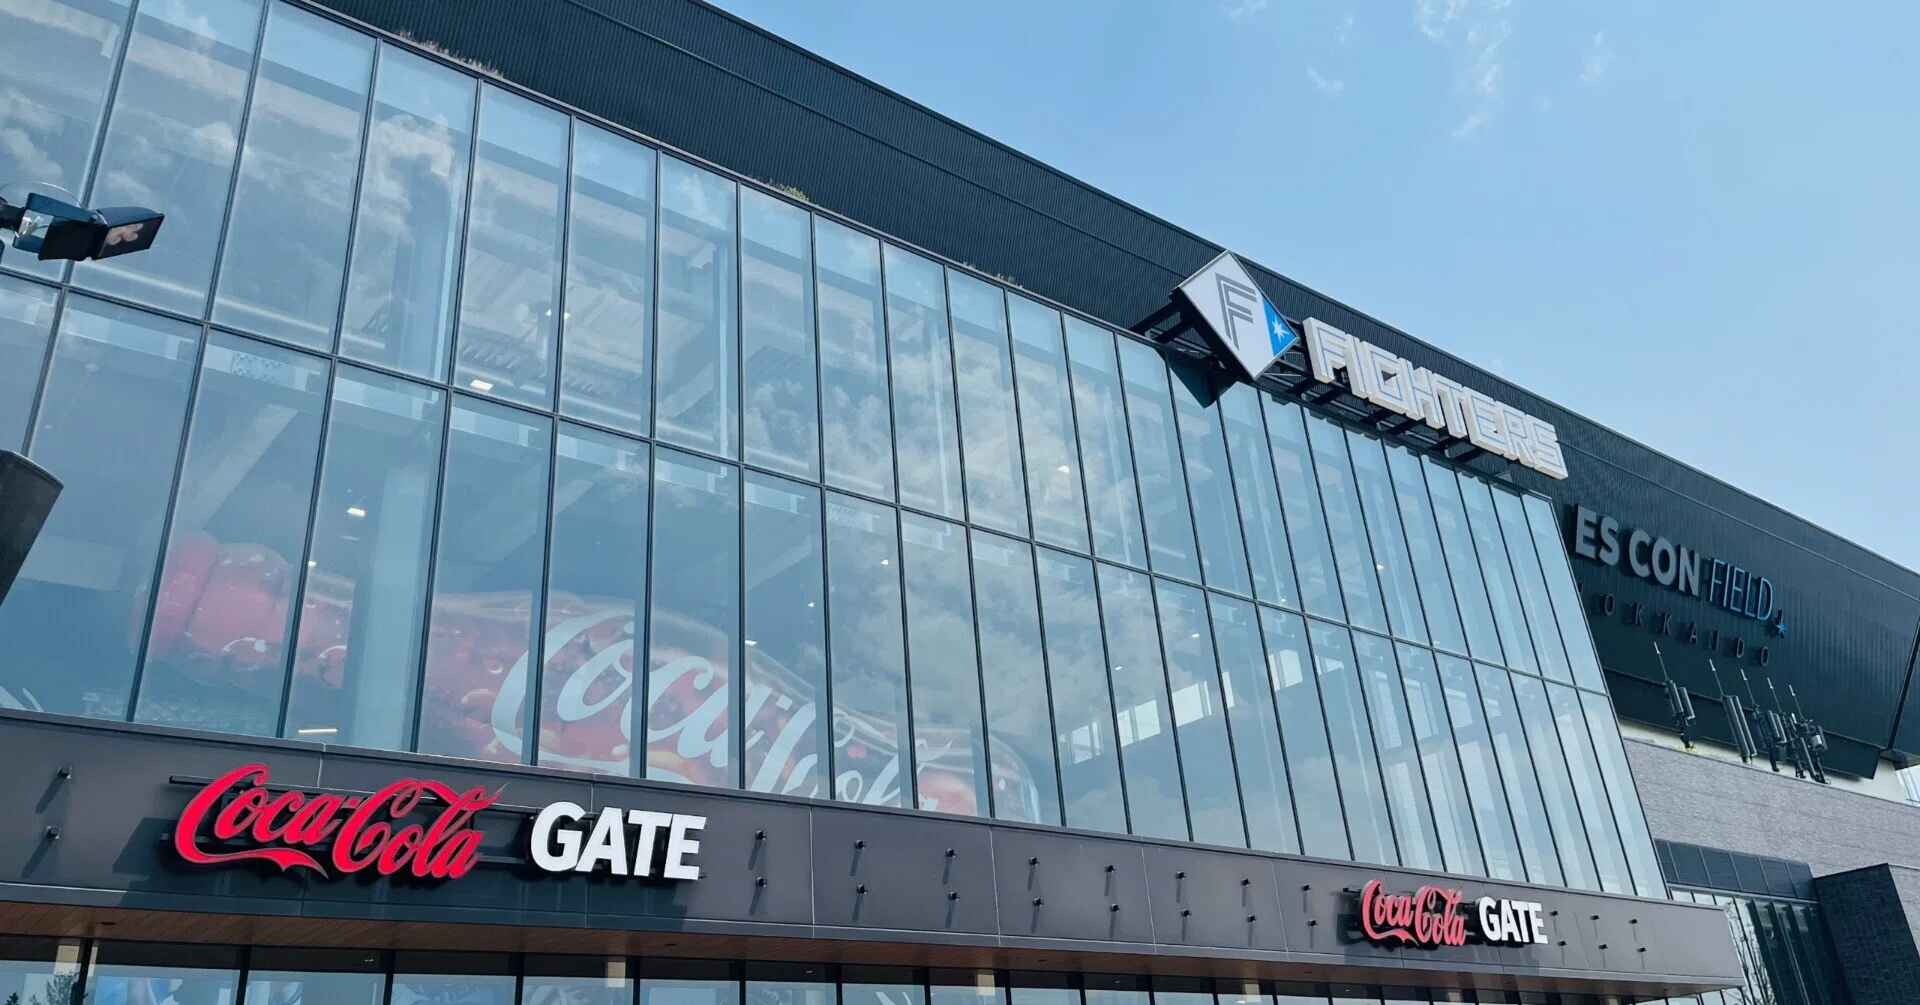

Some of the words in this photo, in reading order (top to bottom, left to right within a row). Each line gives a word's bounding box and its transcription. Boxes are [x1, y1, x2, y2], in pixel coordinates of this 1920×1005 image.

[1302, 316, 1569, 480] FIGHTERS
[1575, 505, 1620, 566] ES
[1629, 529, 1700, 597] CON
[1710, 558, 1773, 621] FIELD
[1578, 583, 1769, 667] OKKAIDO
[174, 762, 509, 879] Coca-Cola
[530, 801, 707, 881] GATE
[1360, 879, 1467, 947] Coca-Cola
[1477, 896, 1549, 944] GATE
